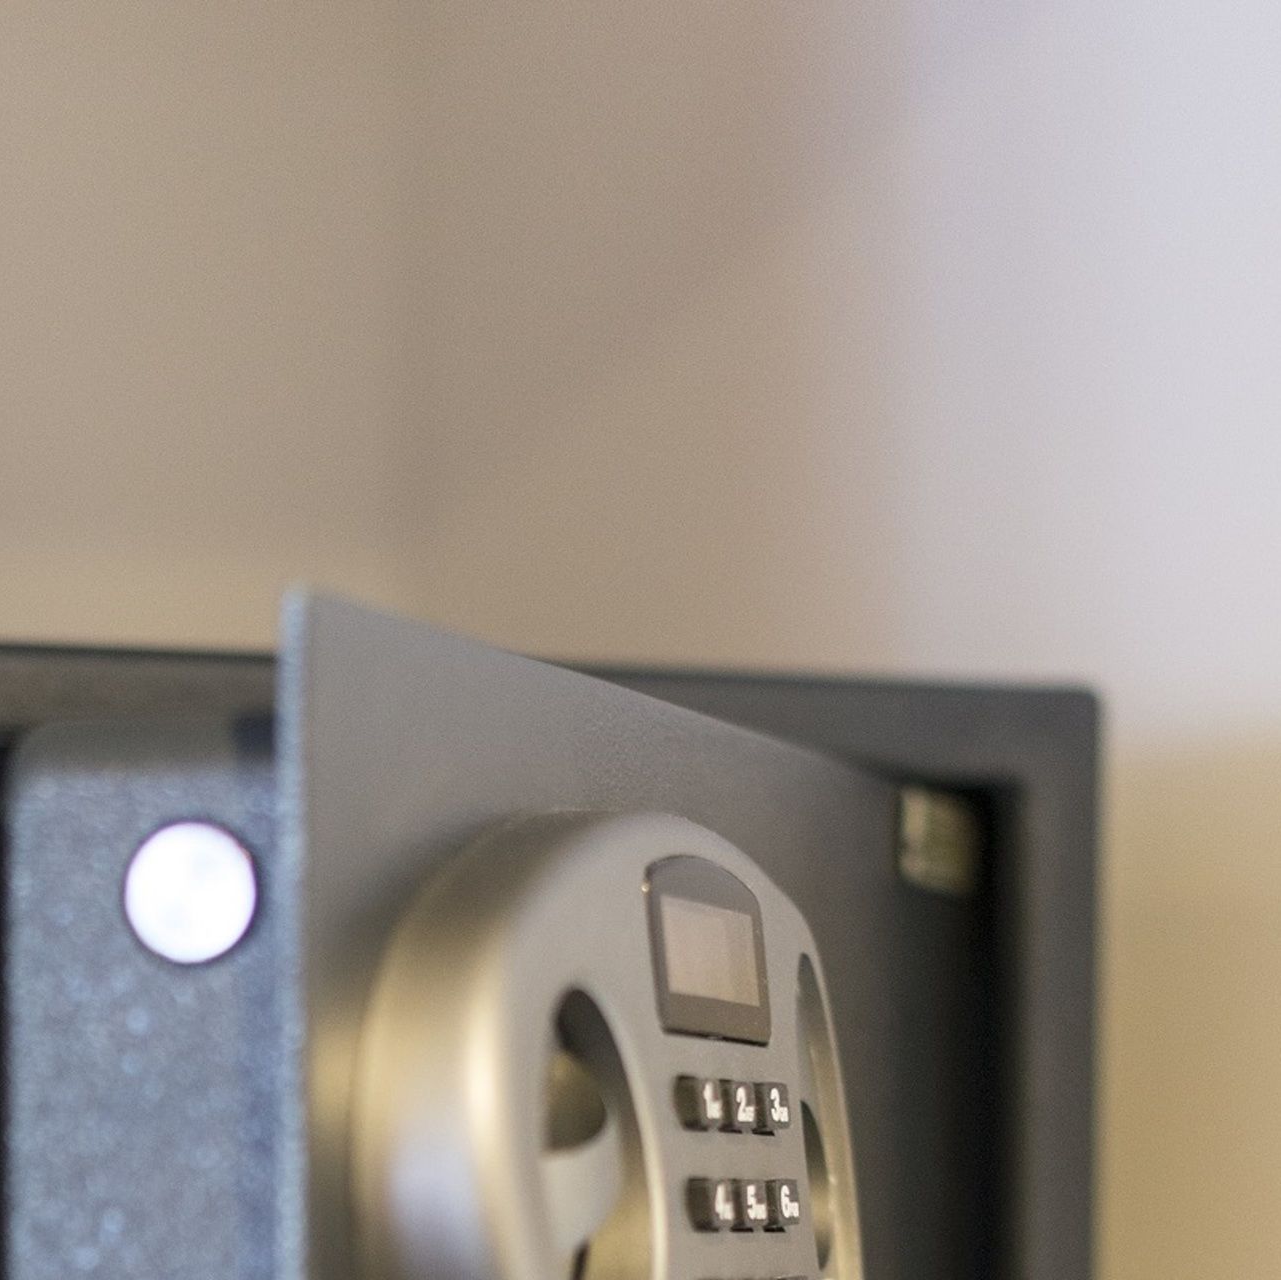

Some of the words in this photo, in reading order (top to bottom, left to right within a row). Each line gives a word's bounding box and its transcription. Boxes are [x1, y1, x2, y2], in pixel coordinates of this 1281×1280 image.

[703, 1082, 714, 1119] 1
[736, 1087, 746, 1122] 2
[771, 1088, 781, 1122] 3
[715, 1184, 726, 1220] 4
[747, 1185, 757, 1220] 5
[781, 1185, 790, 1218] 6
